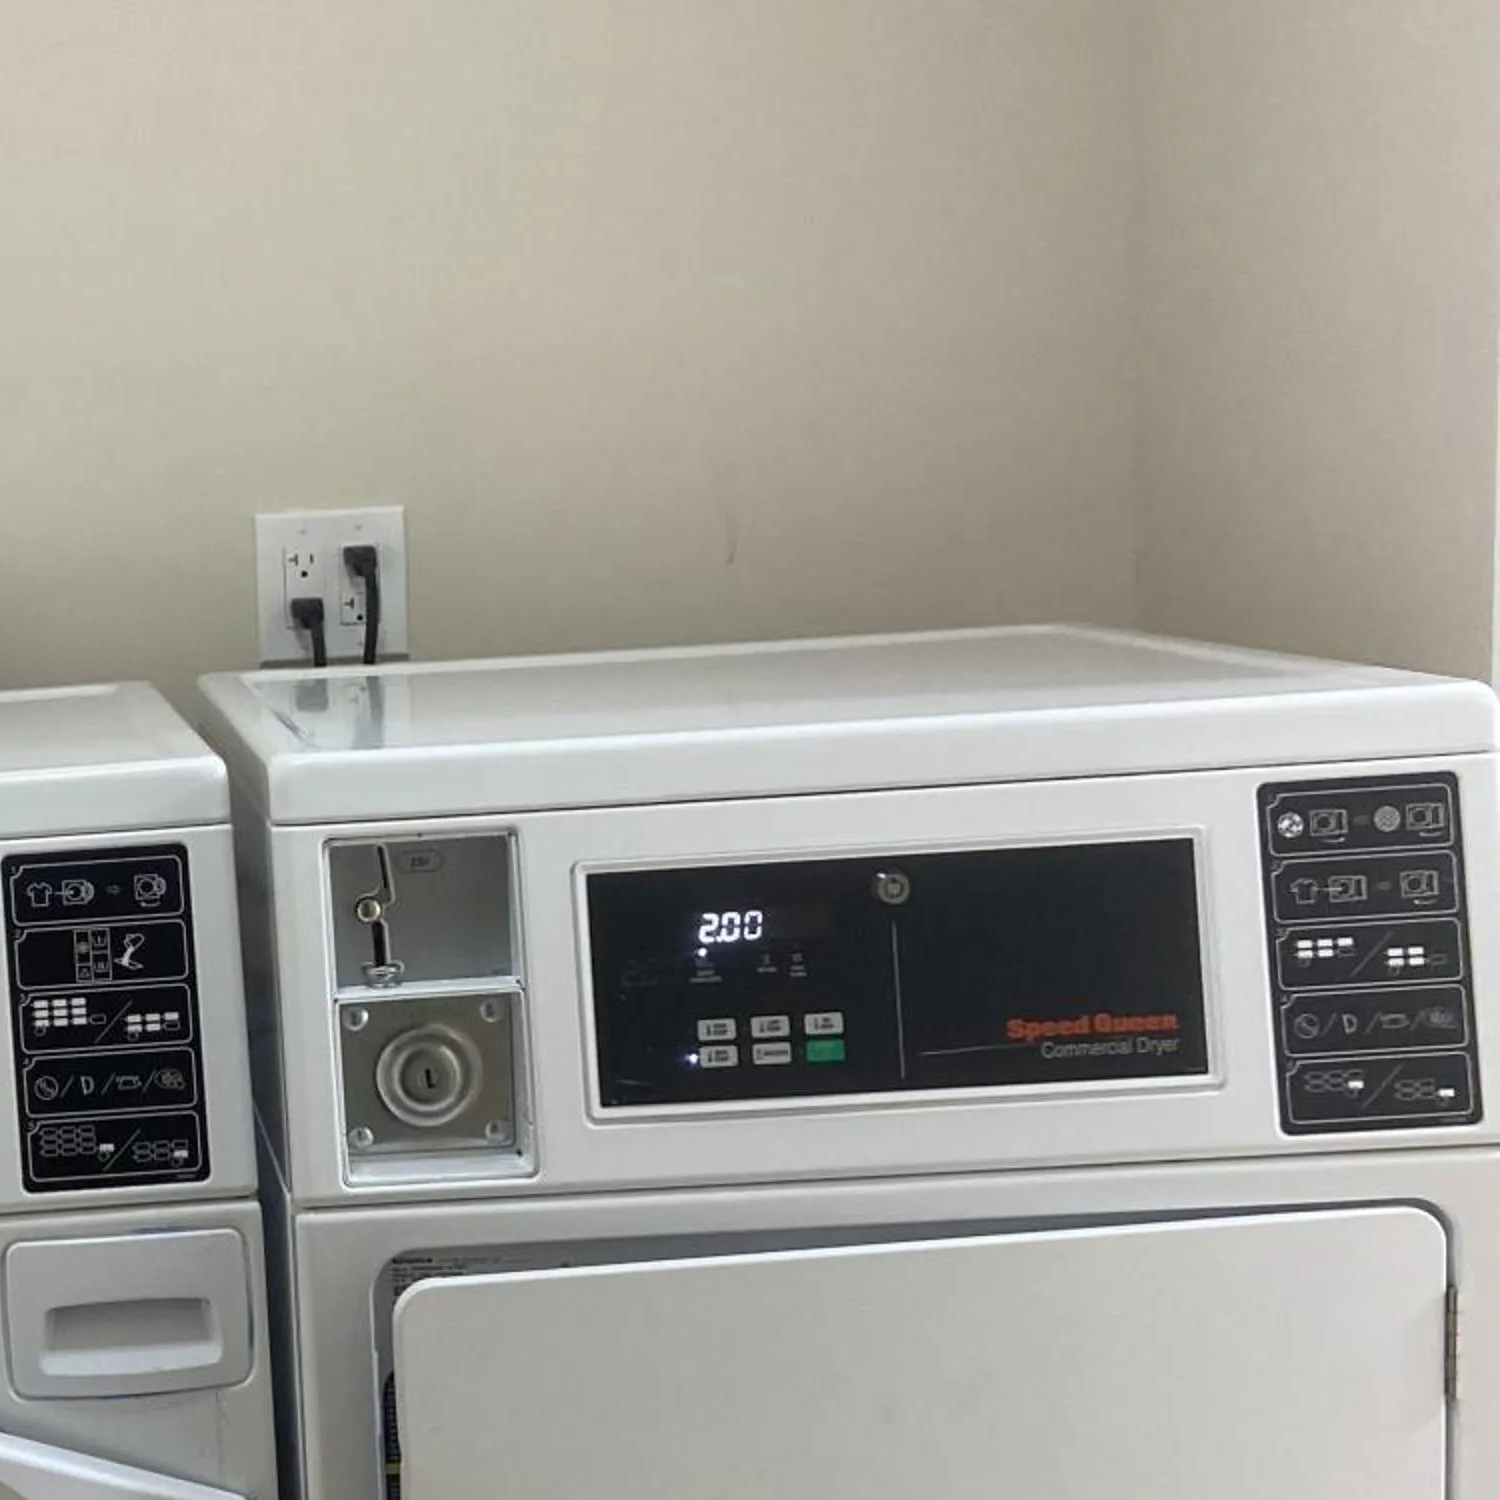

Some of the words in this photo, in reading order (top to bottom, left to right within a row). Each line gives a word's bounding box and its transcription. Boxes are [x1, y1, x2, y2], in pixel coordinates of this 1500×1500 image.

[699, 909, 763, 943] 2.00
[1006, 1015, 1090, 1041] Speed
[1094, 1012, 1179, 1033] Queen
[1041, 1040, 1133, 1059] Commercial
[1136, 1037, 1181, 1056] Dryer
